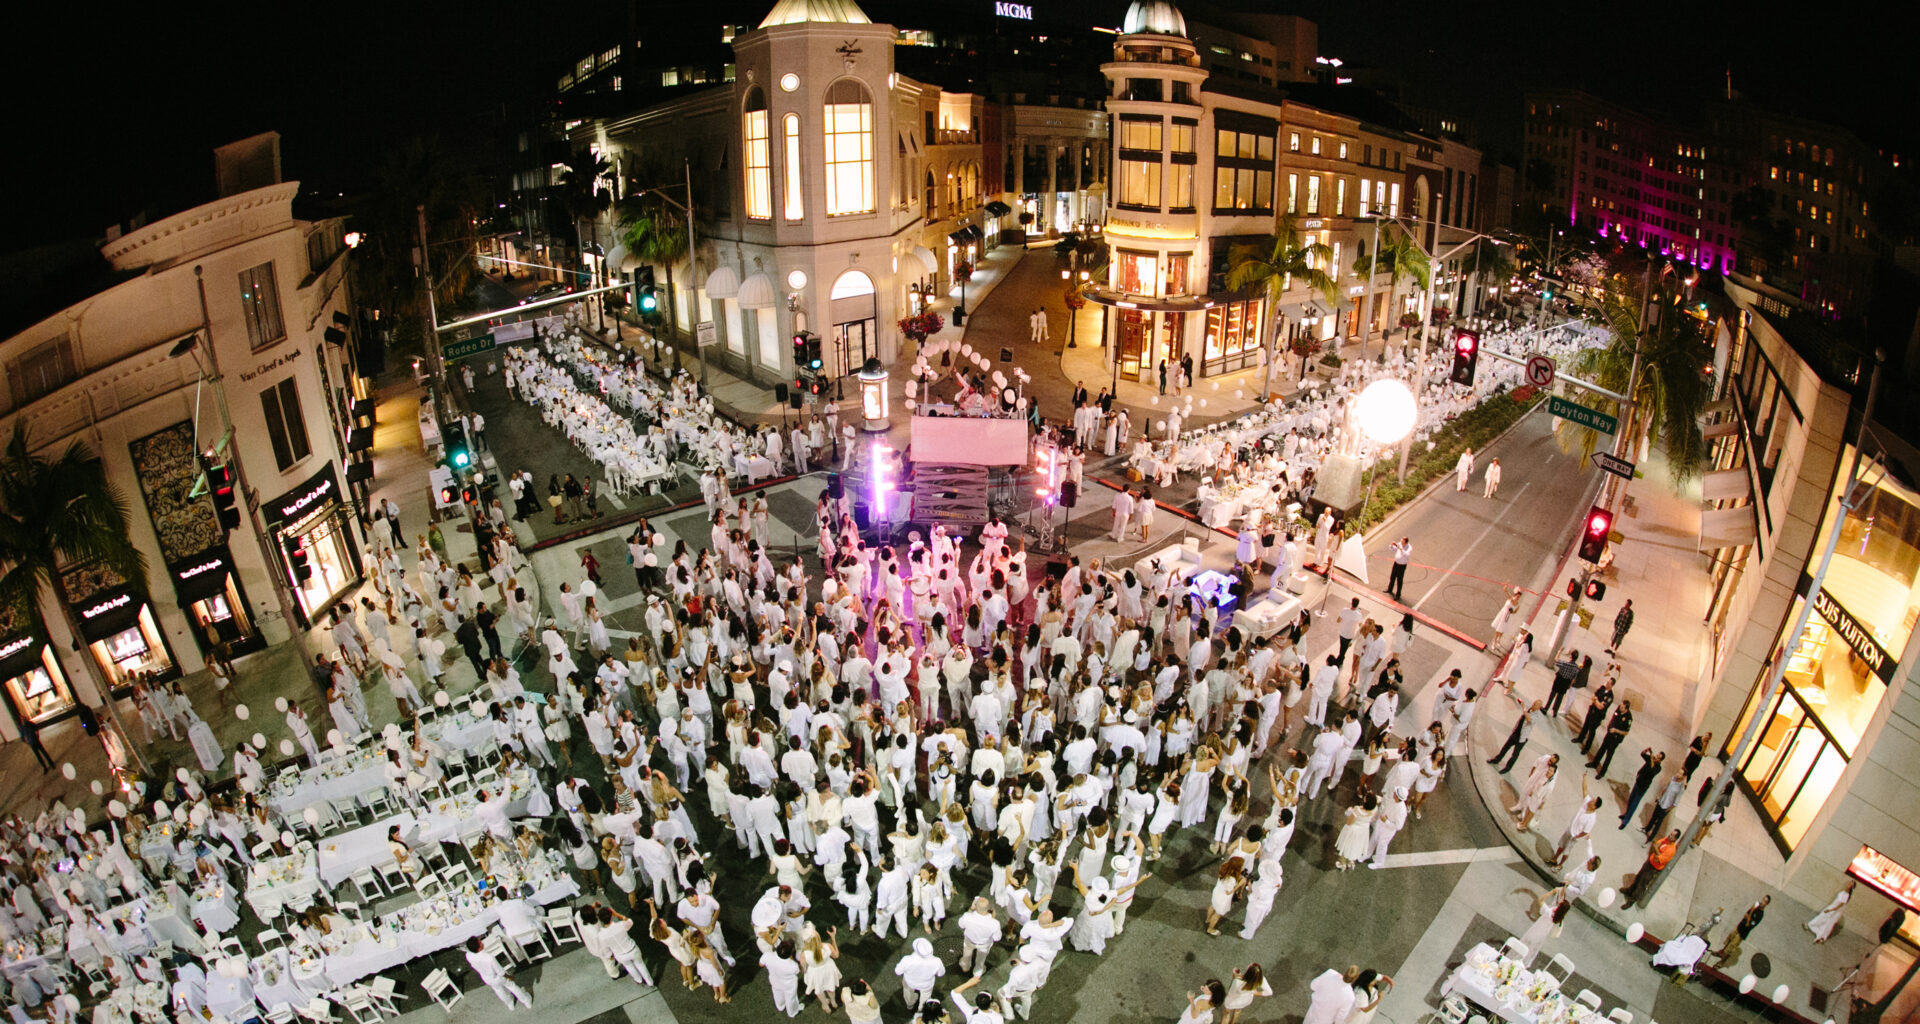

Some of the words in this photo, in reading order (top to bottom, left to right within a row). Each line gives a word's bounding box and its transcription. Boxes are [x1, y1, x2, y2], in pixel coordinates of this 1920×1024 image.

[995, 1, 1033, 20] MGM
[448, 343, 477, 357] Rodeo
[480, 339, 491, 348] Dr
[240, 371, 257, 382] Van
[257, 359, 277, 375] Cleef
[1553, 401, 1589, 423] Dayton
[1592, 414, 1612, 433] Way
[1602, 458, 1616, 468] ONE
[1616, 464, 1630, 473] WAY
[282, 505, 298, 516] Van
[82, 610, 96, 619] Van
[1814, 591, 1840, 625] OUIS
[1839, 613, 1885, 671] VUITTON
